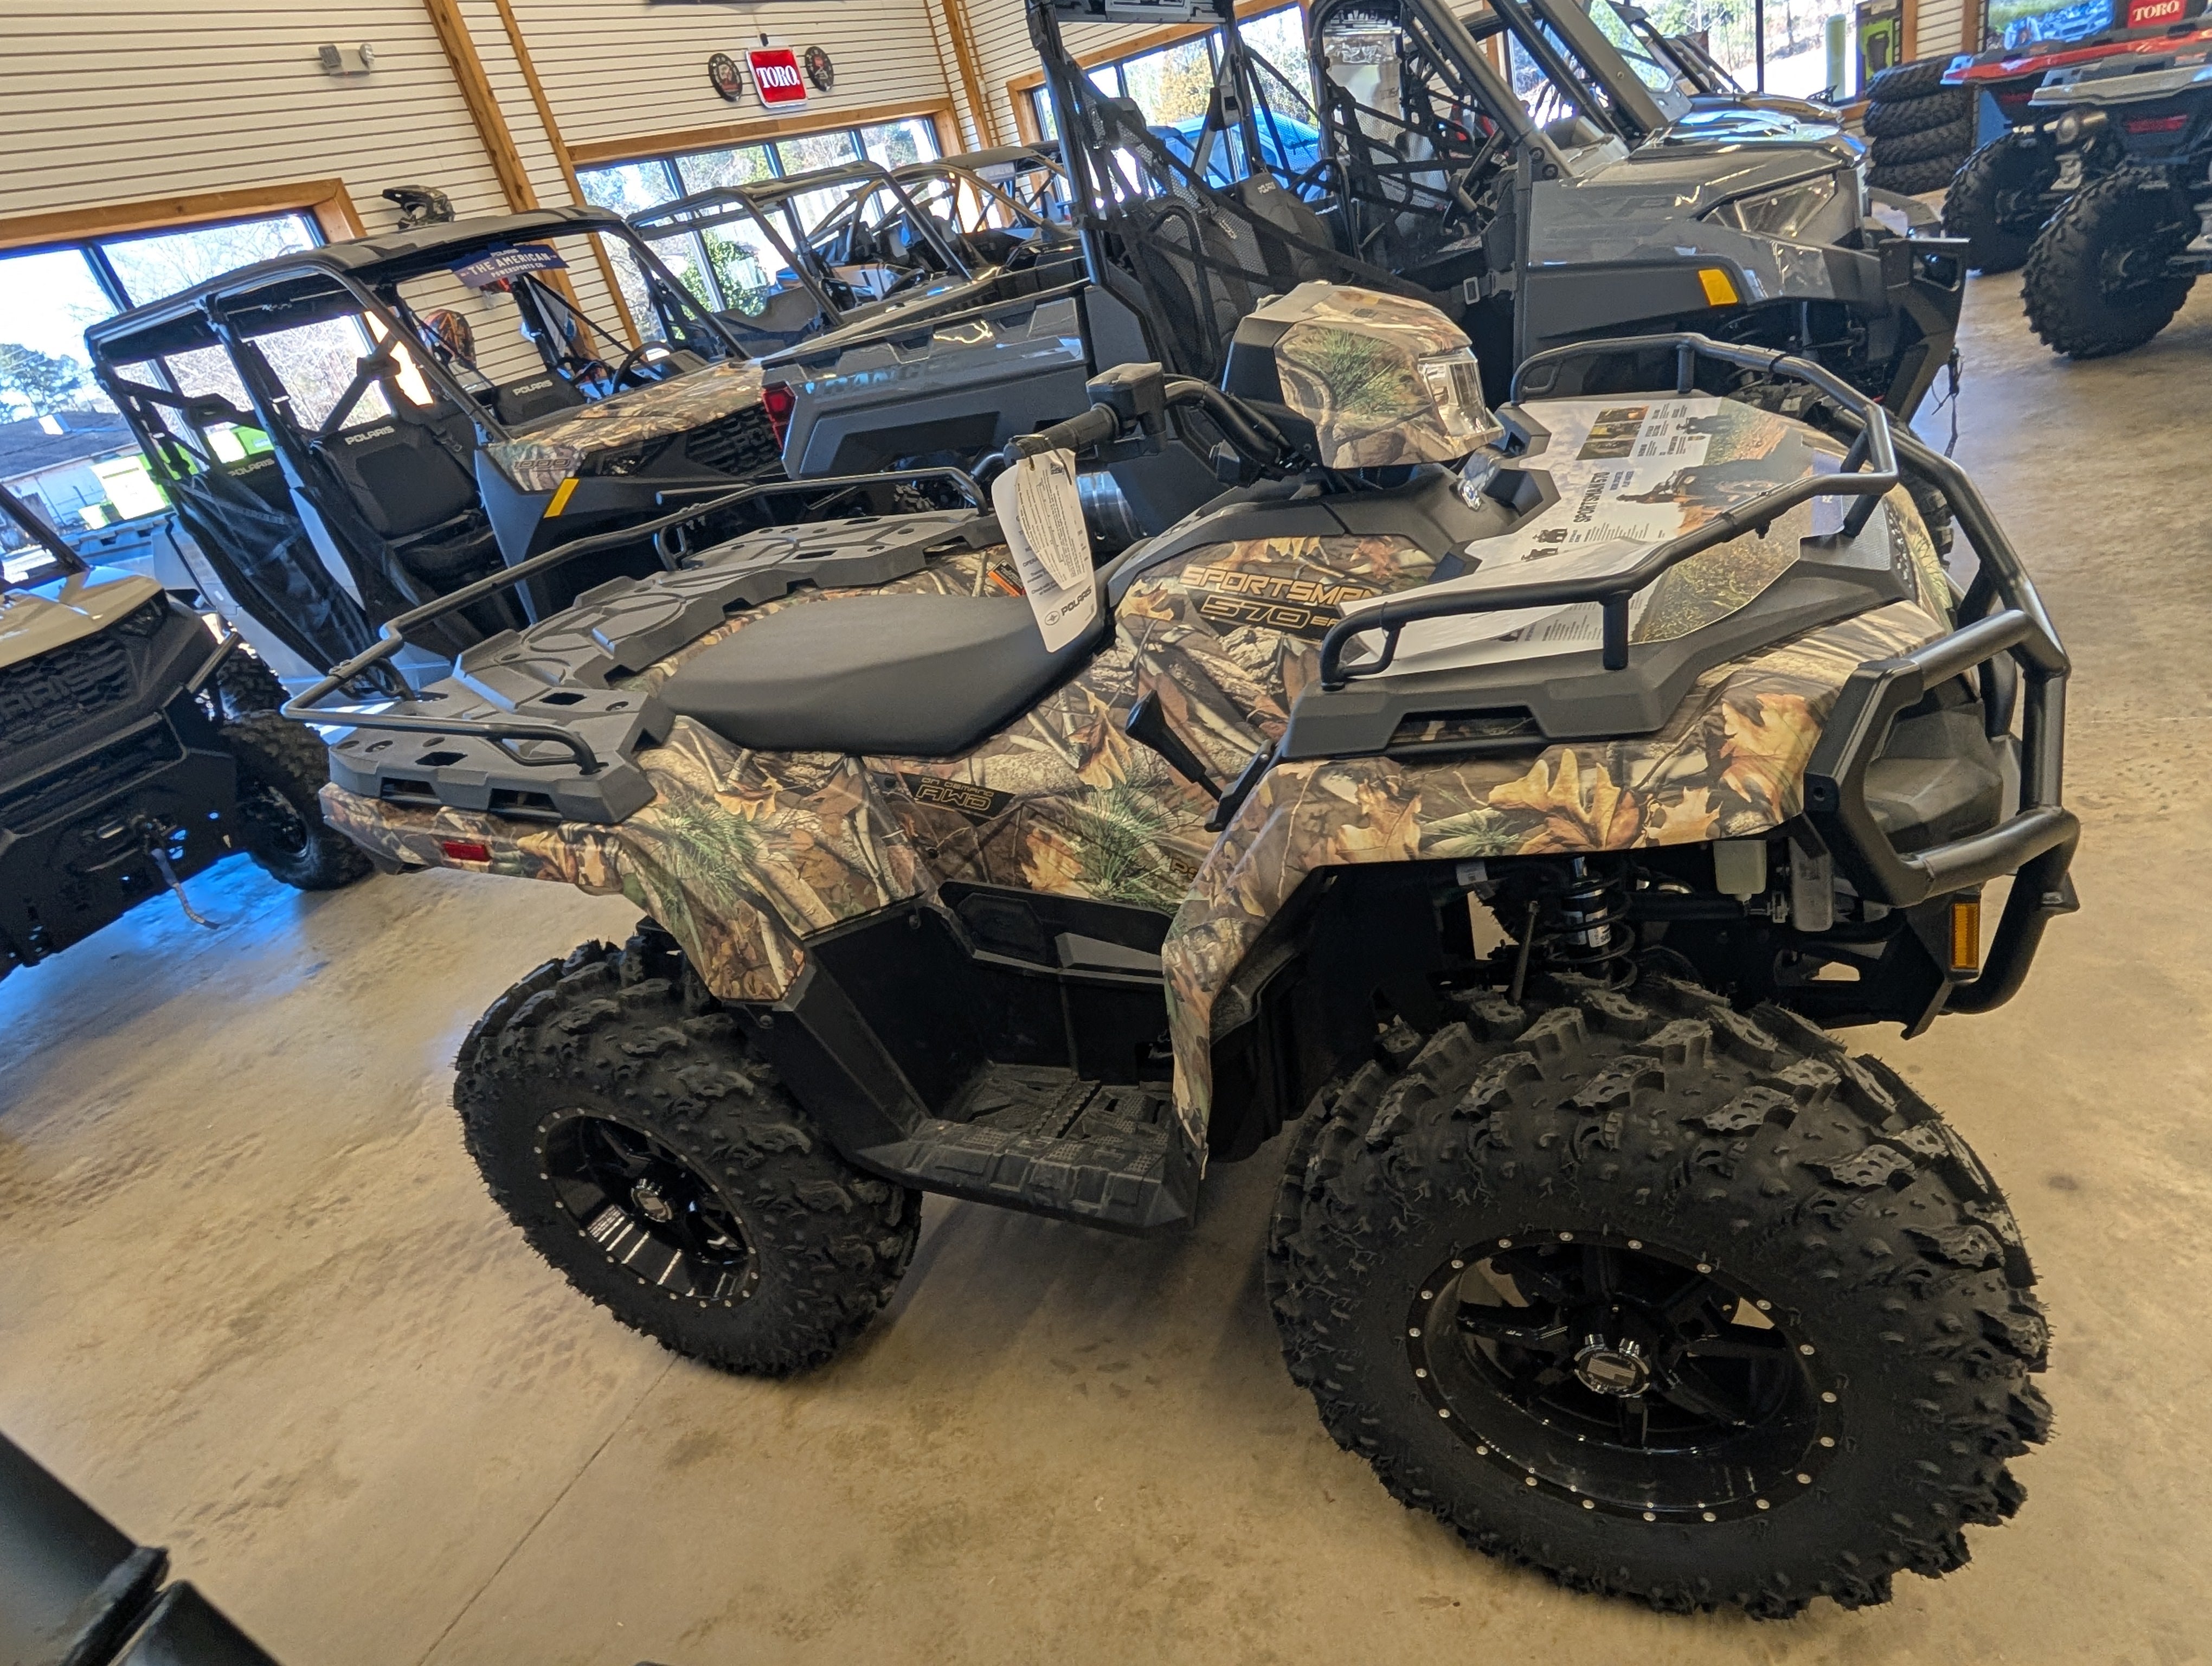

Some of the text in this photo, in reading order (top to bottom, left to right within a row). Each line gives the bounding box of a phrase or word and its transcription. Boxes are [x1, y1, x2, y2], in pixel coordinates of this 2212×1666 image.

[2133, 1, 2179, 21] TORO
[467, 253, 551, 275] THE AMERICAN
[491, 263, 535, 278] POWERSPORTS
[512, 380, 553, 396] POLARIS
[345, 425, 395, 445] POLARIS
[1060, 586, 1092, 617] POLARIS
[1200, 595, 1311, 629] 570
[916, 784, 991, 811] AWD
